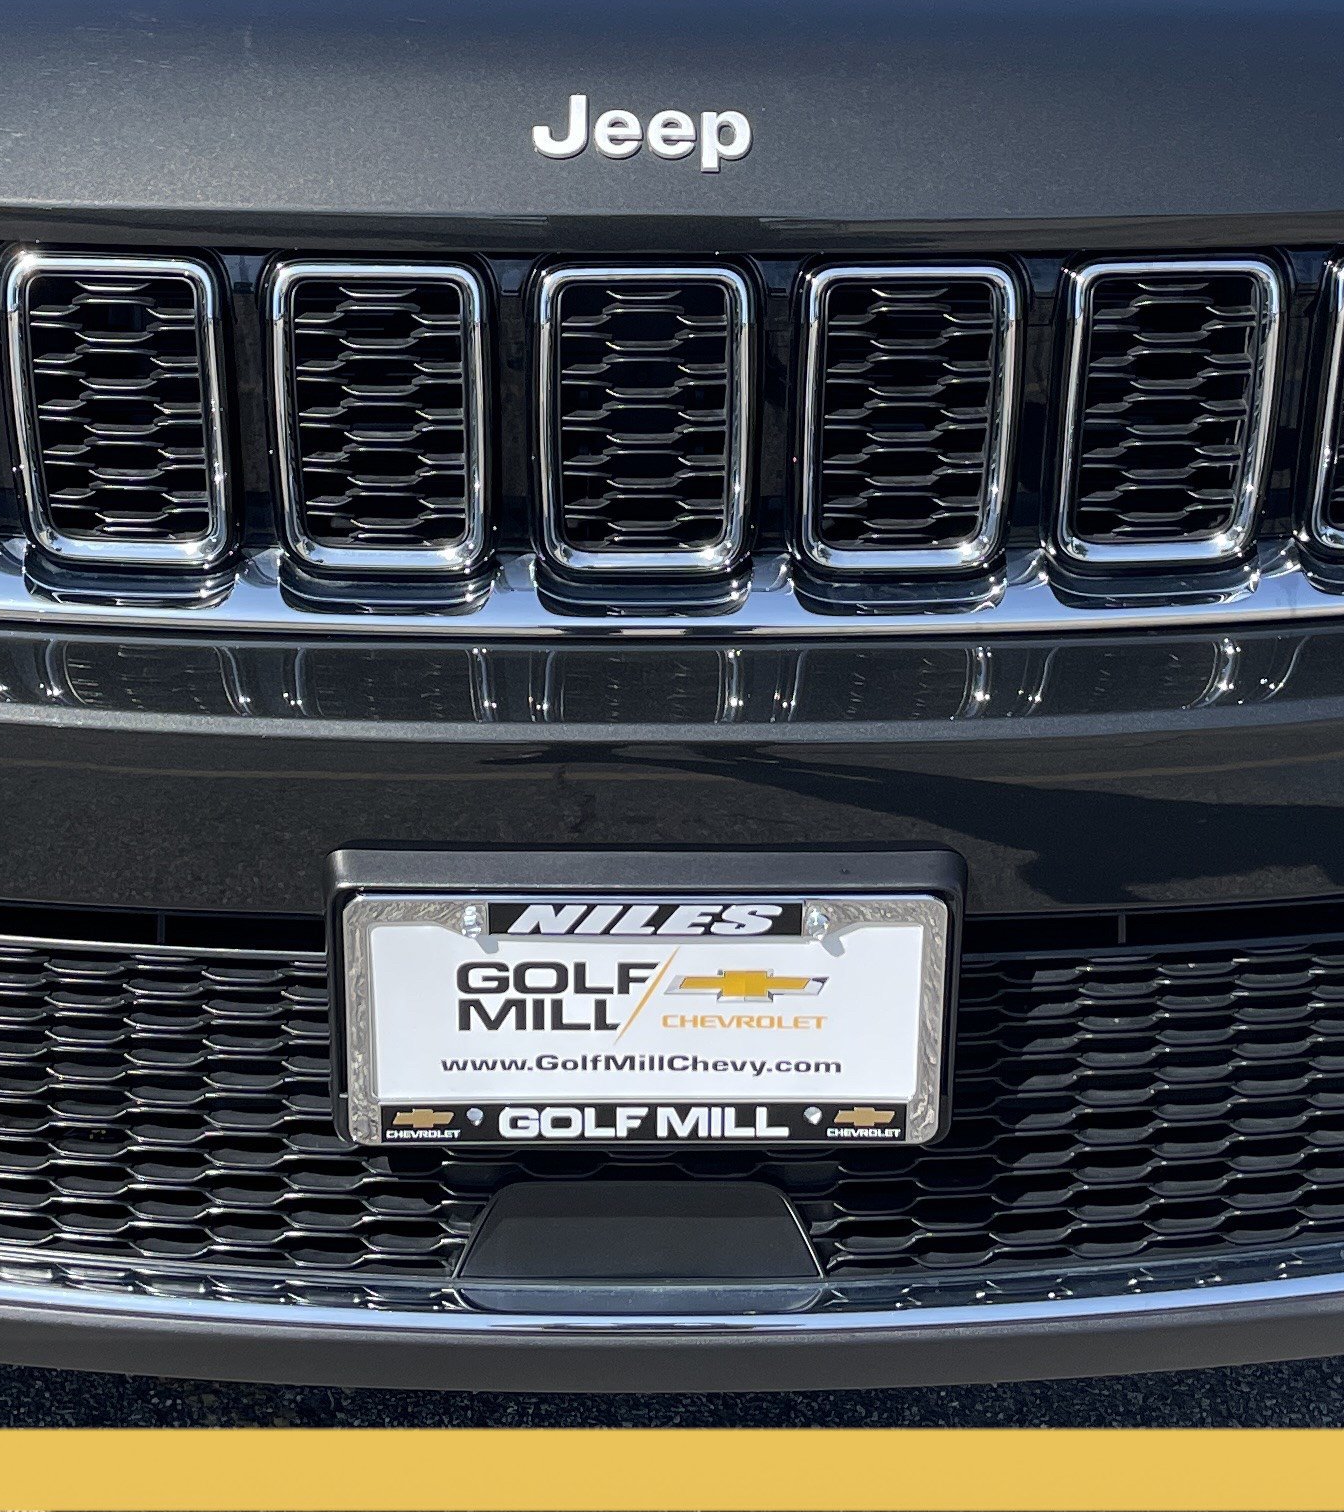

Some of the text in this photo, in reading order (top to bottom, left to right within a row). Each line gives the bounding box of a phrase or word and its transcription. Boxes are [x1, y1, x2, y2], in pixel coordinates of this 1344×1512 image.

[532, 94, 753, 173] Jeep
[506, 904, 782, 936] NILES
[456, 961, 659, 995] GOLF
[456, 998, 620, 1032] MILL
[661, 1013, 828, 1031] CHEVROLET
[441, 1053, 843, 1077] www.GolfMillChevy.com
[386, 1128, 461, 1139] CHEVROLET
[498, 1106, 790, 1138] GOLF MILL
[827, 1127, 902, 1138] CHEVROLET
